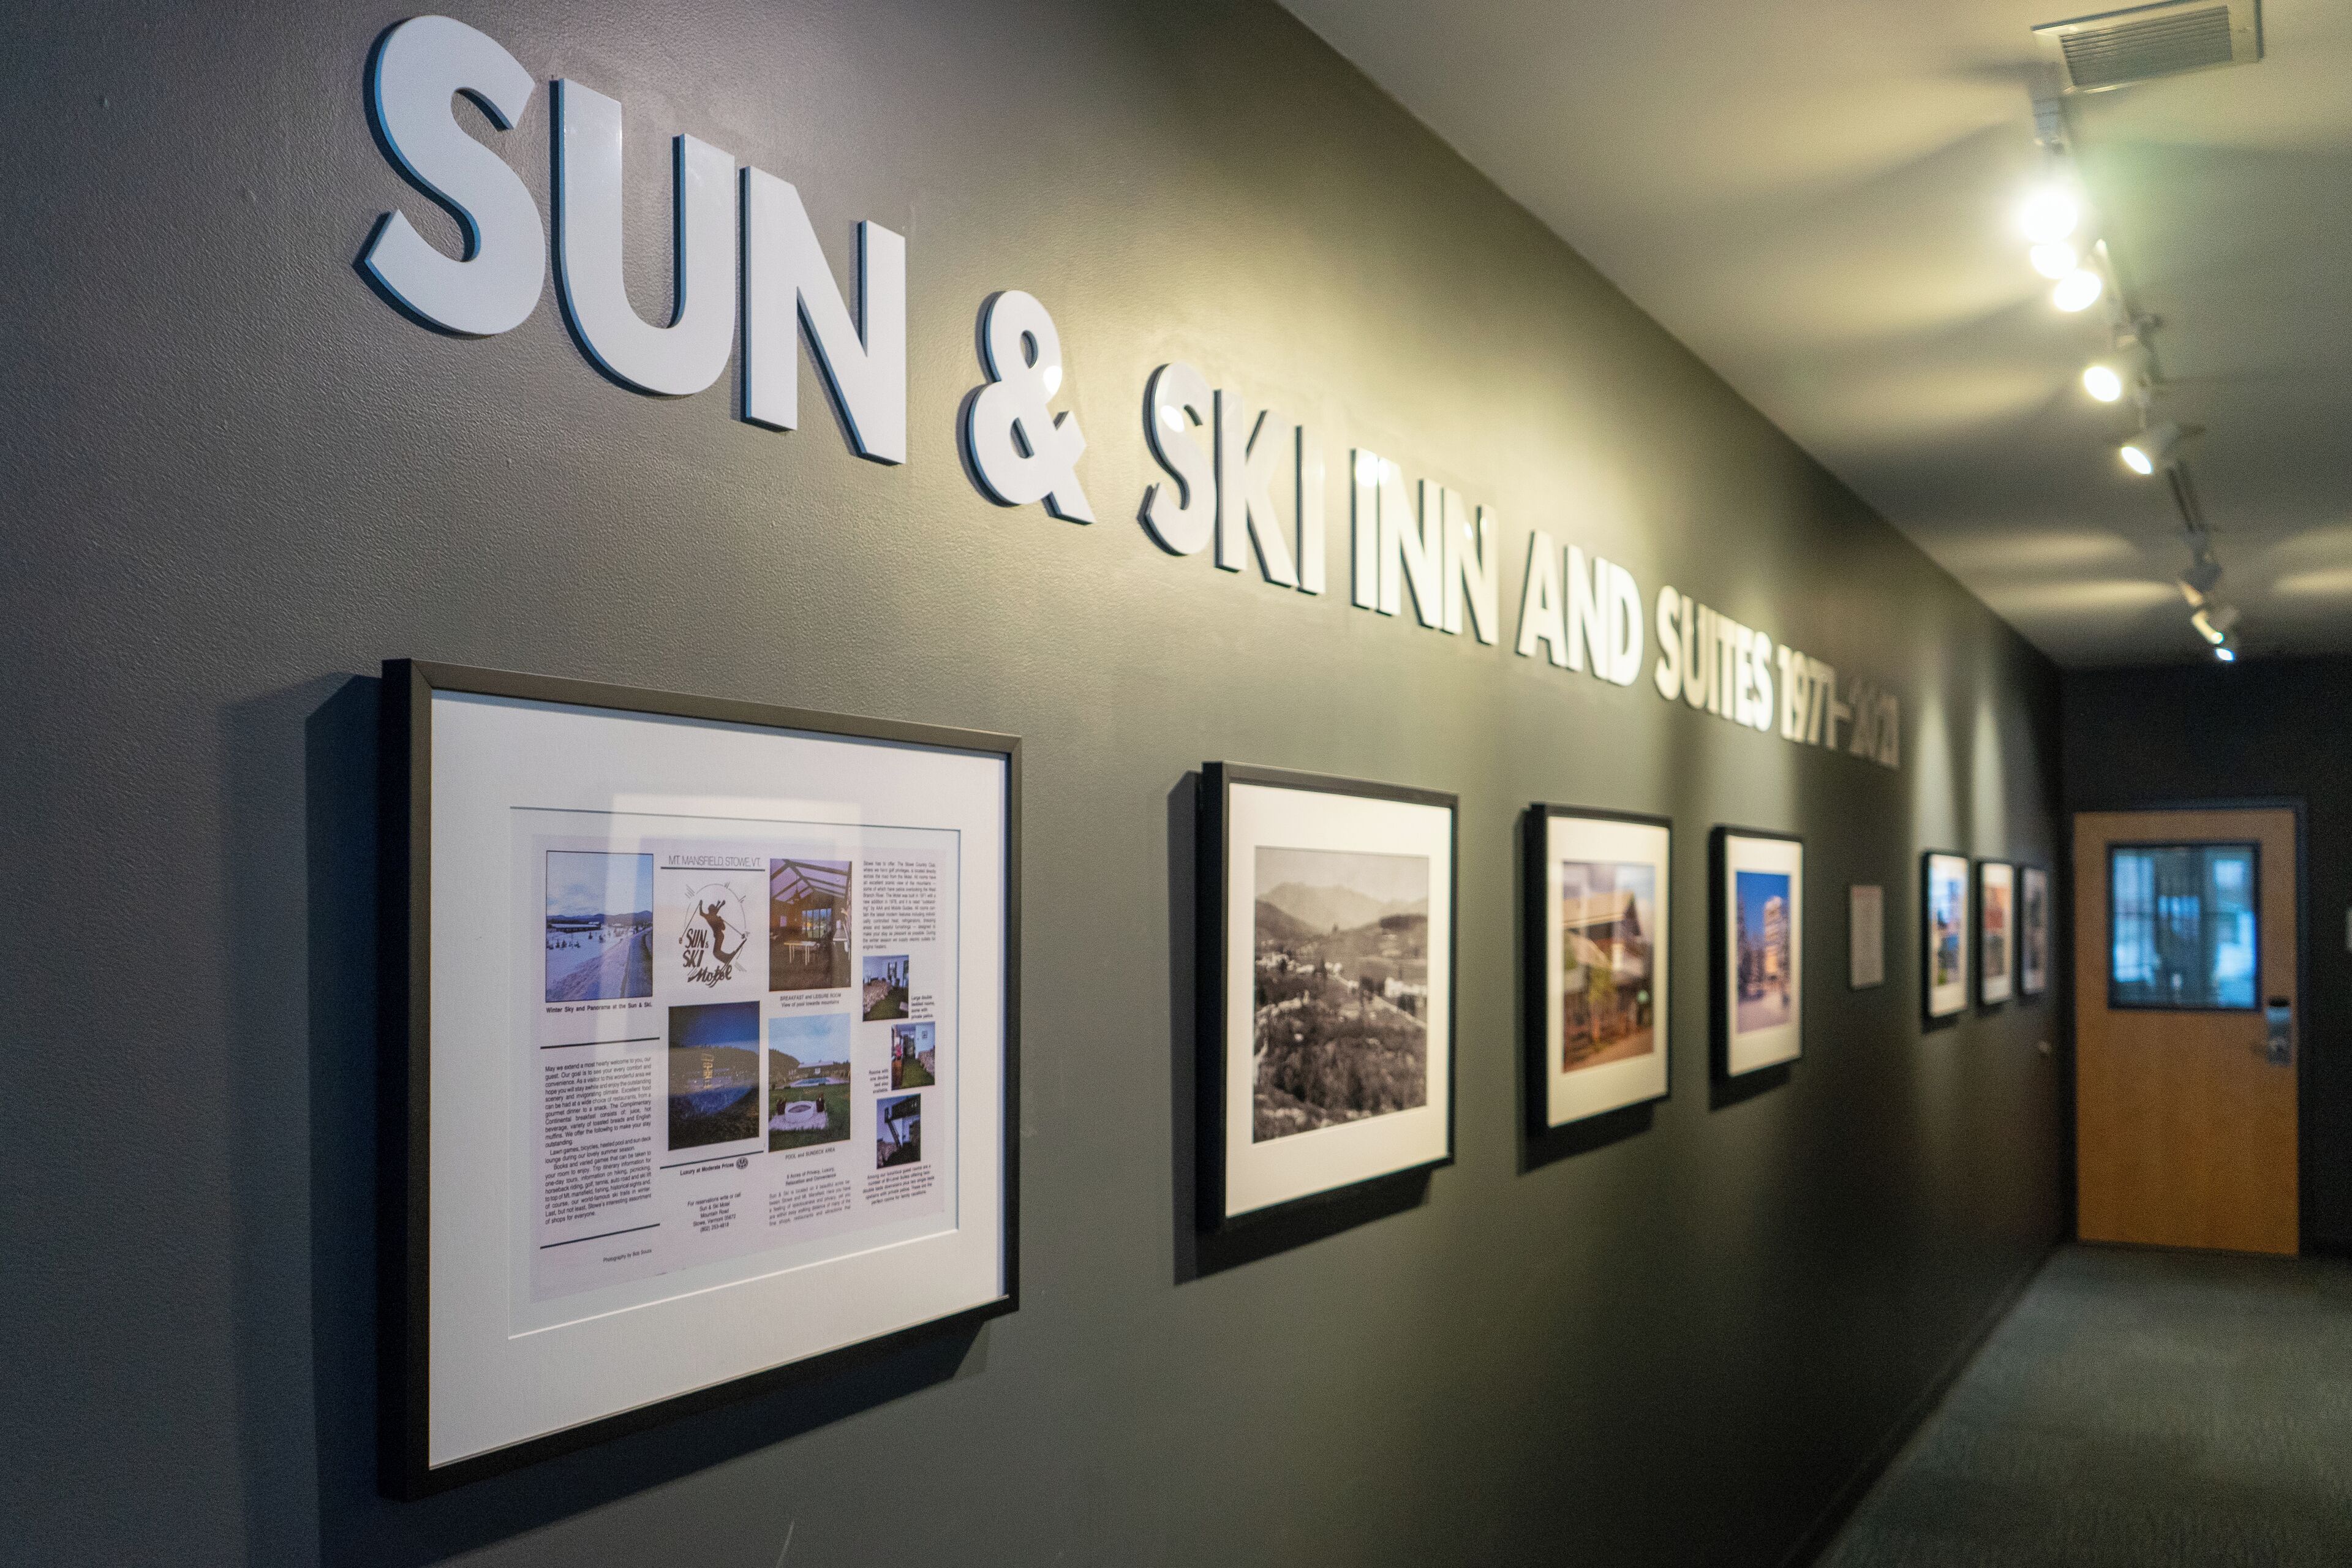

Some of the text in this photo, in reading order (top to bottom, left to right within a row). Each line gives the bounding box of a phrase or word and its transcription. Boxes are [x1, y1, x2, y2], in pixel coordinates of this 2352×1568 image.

[361, 15, 907, 464] SUN
[962, 289, 1095, 524] &
[1137, 362, 1326, 595] SKI
[1351, 447, 1499, 646] INN
[1516, 529, 1644, 687] AND
[1655, 585, 1774, 732] SUITES
[685, 928, 707, 948] SUN
[683, 949, 704, 967] SKI
[687, 964, 732, 984] Motel
